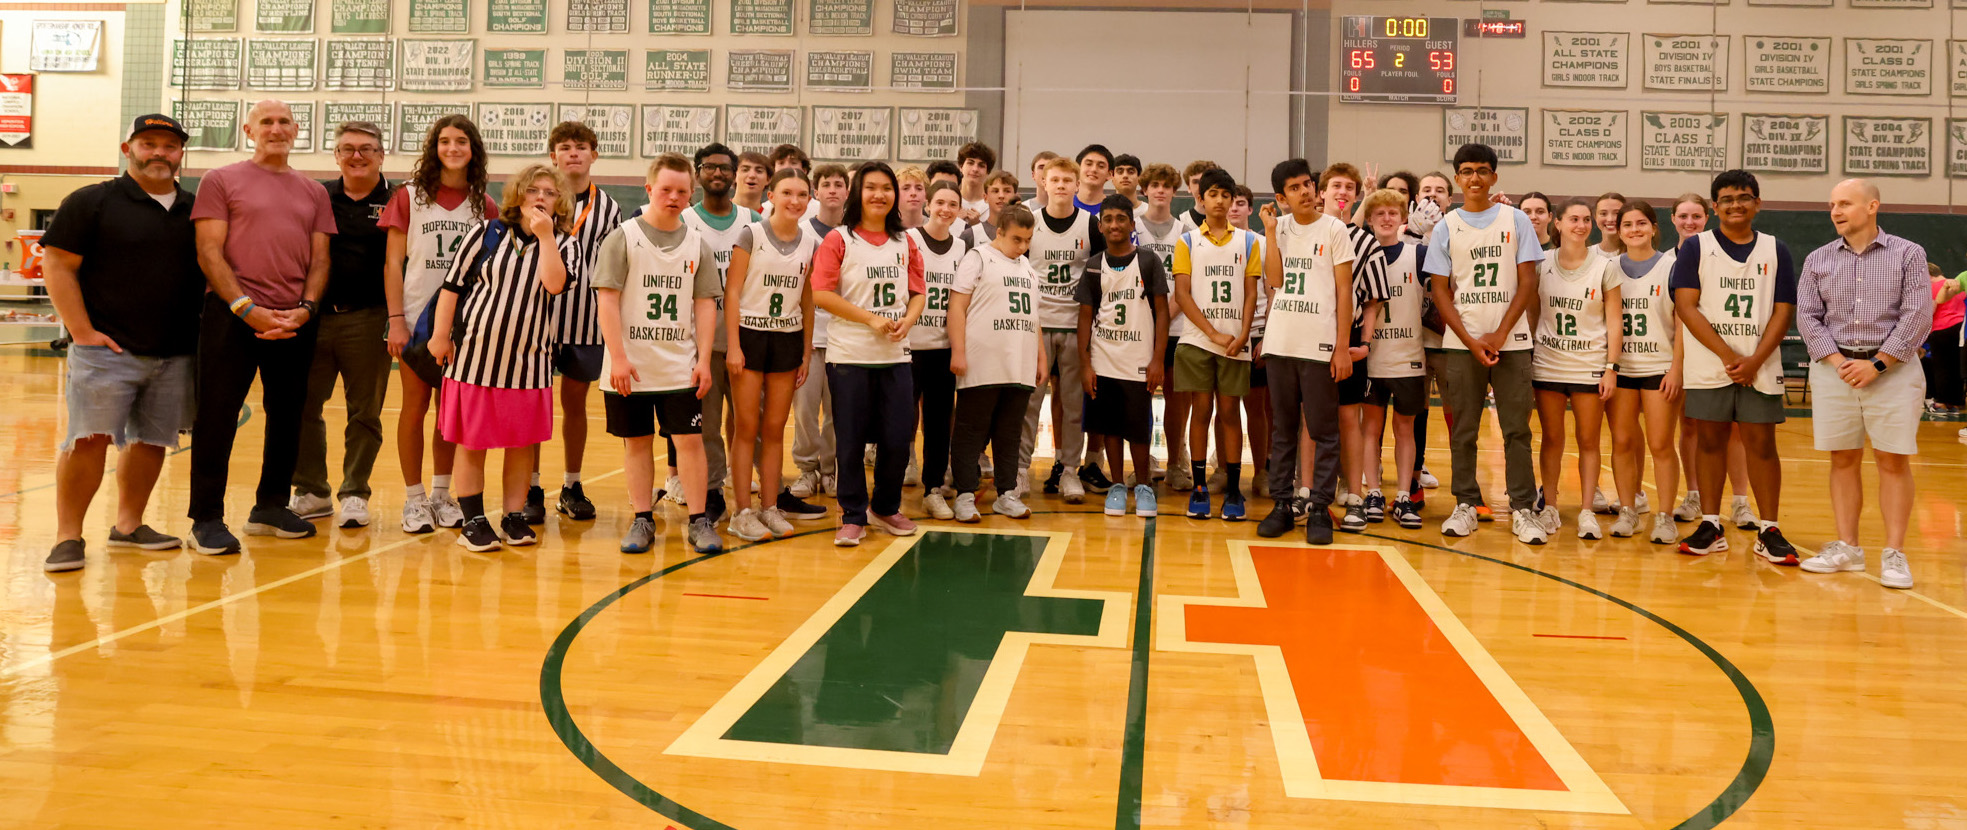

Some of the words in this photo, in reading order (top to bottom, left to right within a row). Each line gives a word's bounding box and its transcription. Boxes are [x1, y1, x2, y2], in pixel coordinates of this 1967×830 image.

[1386, 18, 1426, 37] 0:00
[1344, 40, 1378, 48] HILLERS
[1426, 41, 1452, 49] GUEST
[252, 51, 311, 59] CHAMPIONS
[427, 46, 449, 54] 2022
[1351, 51, 1374, 68] 65
[1395, 53, 1404, 67] 2
[1430, 52, 1453, 70] 53
[1760, 54, 1800, 62] DIVISION
[1863, 57, 1903, 65] CLASS
[648, 62, 668, 70] ALL
[674, 62, 707, 70] STATE
[1553, 61, 1618, 69] CHAMPIONS
[1777, 66, 1818, 74] BASKETBALL
[428, 68, 469, 76] CHAMPIONS
[1852, 69, 1876, 77] STATE
[1880, 69, 1925, 77] CHAMPIONS
[1350, 77, 1359, 91] 0
[1650, 76, 1674, 84] STATE
[1750, 78, 1774, 86] STATE
[1778, 78, 1824, 87] CHAMPIONS
[1901, 81, 1921, 89] TRACK
[1443, 79, 1452, 93] 0
[751, 122, 766, 130] DIV.
[769, 122, 777, 130] IV
[838, 123, 855, 131] DIV.
[859, 123, 865, 131] II
[925, 124, 942, 132] DIV.
[946, 124, 952, 132] II
[1670, 118, 1700, 128] 2003
[1770, 121, 1799, 129] 2004
[481, 130, 503, 139] STATE
[507, 130, 547, 139] FINALISTS
[647, 132, 668, 141] STATE
[672, 133, 710, 142] FINALISTS
[817, 134, 837, 144] STATE
[840, 134, 886, 145] CHAMPIONS
[1448, 135, 1471, 145] STATE
[1655, 134, 1698, 143] CLASS
[1872, 135, 1890, 143] DIV.
[903, 136, 924, 145] STATE
[928, 136, 974, 146] CHAMPIONS
[511, 143, 543, 151] SOCCER
[840, 148, 861, 157] GOLF
[1645, 146, 1670, 156] STATE
[1676, 146, 1724, 157] CHAMPIONS
[1747, 144, 1771, 153] STATE
[1773, 144, 1822, 155] CHAMPIONS
[1849, 146, 1872, 156] STATE
[1876, 147, 1926, 157] CHAMPIONS
[928, 149, 948, 157] GOLF
[1645, 158, 1665, 166] GIRLS
[1747, 157, 1768, 166] GIRLS
[1801, 158, 1822, 167] TRACK
[1849, 160, 1869, 168] GIRLS
[1902, 161, 1926, 170] TRACK
[1045, 251, 1075, 260] UNIFIED
[1471, 246, 1501, 259] UNIFIED
[1285, 257, 1312, 269] UNIFIED
[867, 266, 899, 279] UNIFIED
[1048, 264, 1071, 284] 20
[1205, 266, 1233, 276] UNIFIED
[1474, 263, 1498, 287] 27
[643, 275, 682, 289] UNIFIED
[764, 274, 798, 288] UNIFIED
[926, 272, 953, 284] UNIFIED
[1004, 277, 1031, 289] UNIFIED
[1720, 277, 1755, 290] UNIFIED
[1285, 273, 1305, 295] 21
[874, 283, 895, 307] 16
[1109, 289, 1134, 302] UNIFIED
[1212, 281, 1231, 303] 13
[1460, 291, 1509, 304] BASKETBALL
[928, 288, 948, 310] 22
[1009, 292, 1030, 314] 50
[1550, 296, 1582, 311] UNIFIED
[1622, 298, 1648, 309] NIFIED
[647, 294, 677, 321] 34
[769, 293, 783, 317] 8
[1273, 300, 1319, 314] BASKETBALL
[1725, 294, 1753, 318] 47
[1115, 304, 1126, 325] 3
[1203, 308, 1241, 320] ASKETBALL
[745, 316, 799, 328] BASKETBALL
[1556, 313, 1577, 336] 12
[1622, 314, 1647, 336] 33
[630, 326, 685, 341] BASKETBALL
[1097, 327, 1141, 341] BASKETBALL
[1542, 336, 1591, 351] BASKETBALL
